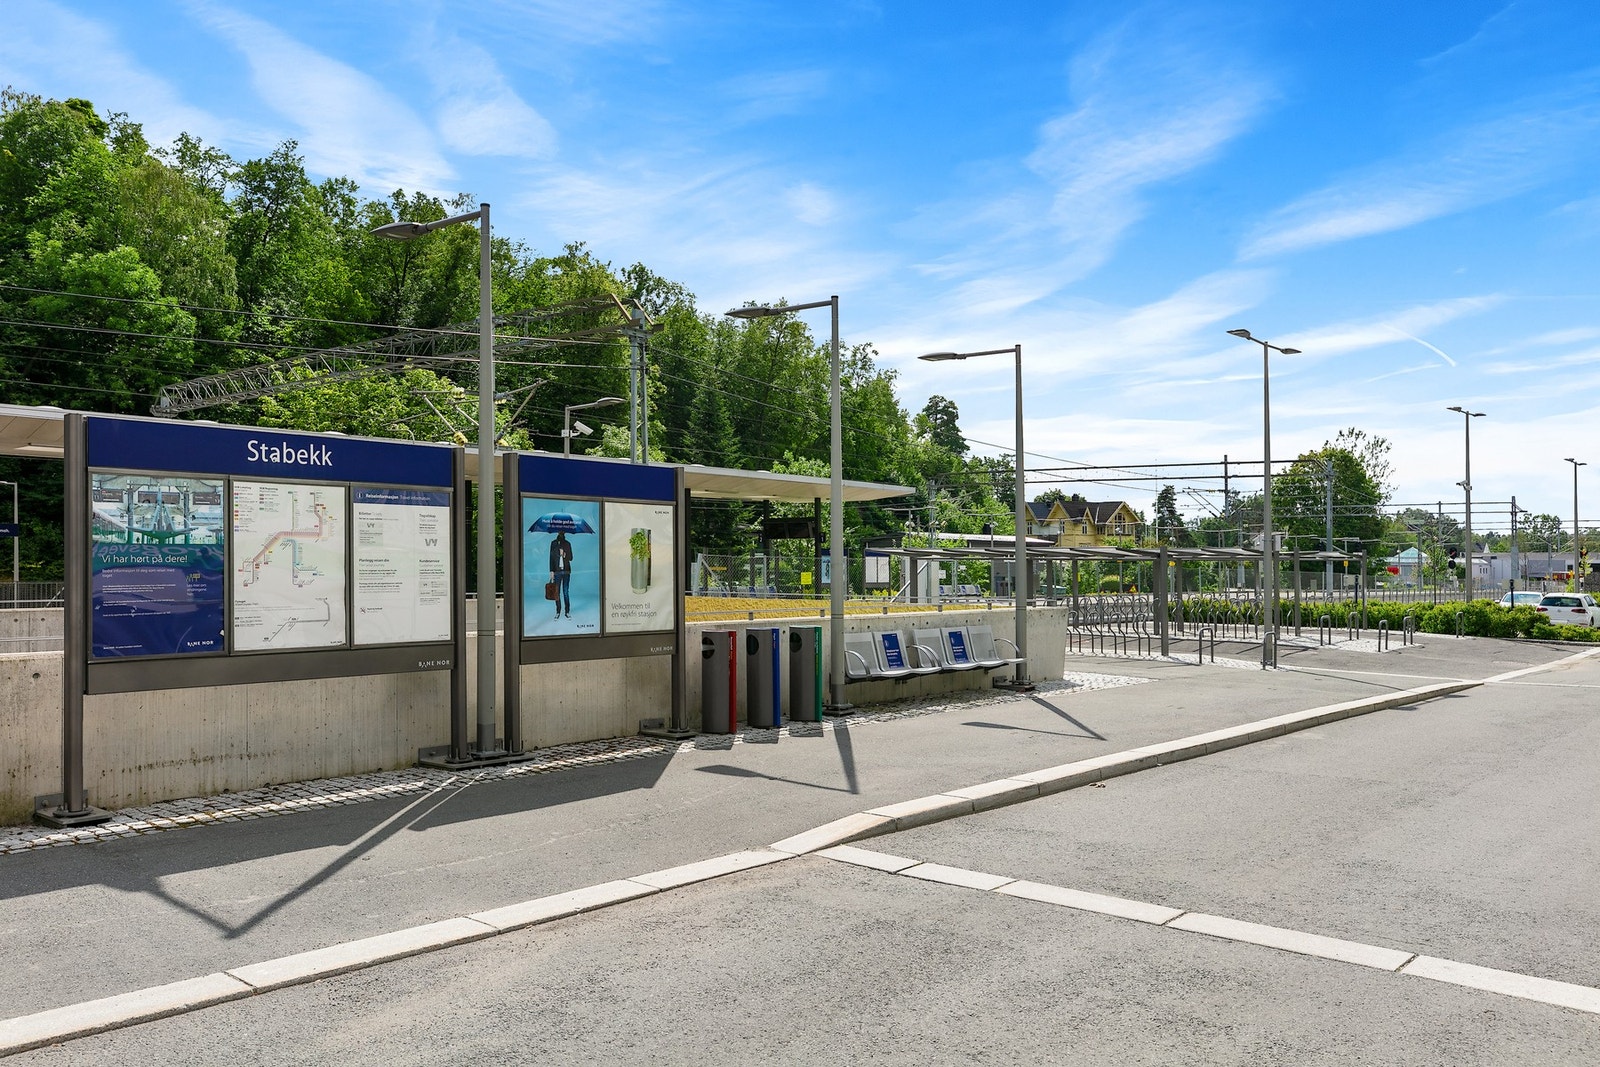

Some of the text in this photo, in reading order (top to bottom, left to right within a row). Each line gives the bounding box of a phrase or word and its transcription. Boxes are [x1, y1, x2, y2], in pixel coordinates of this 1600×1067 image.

[247, 439, 333, 466] Stabekk
[152, 554, 163, 565] på
[620, 610, 637, 619] røykfri
